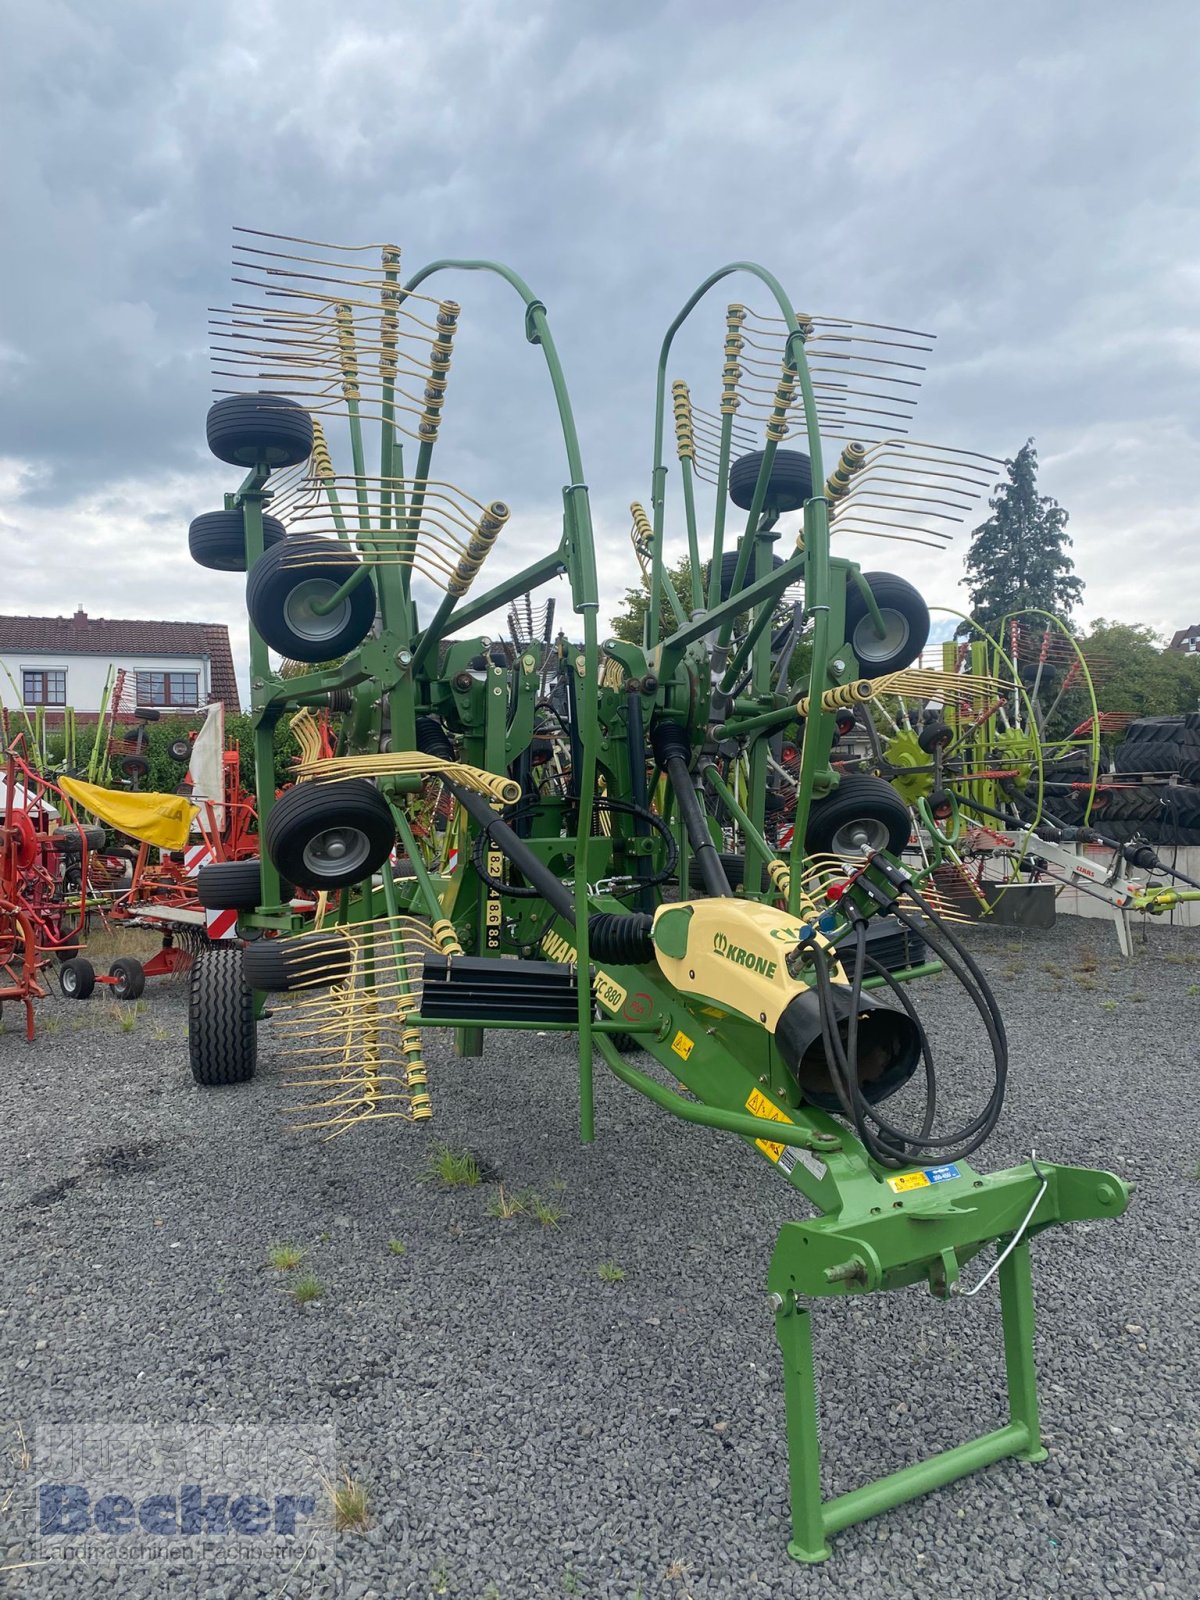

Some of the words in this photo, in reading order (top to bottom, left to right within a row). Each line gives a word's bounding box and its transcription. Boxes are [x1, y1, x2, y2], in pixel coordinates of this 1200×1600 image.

[490, 855, 501, 874] 8.2
[489, 904, 500, 923] 8.6
[488, 928, 500, 948] 8.8
[726, 943, 778, 980] KRONE
[595, 977, 608, 995] TC
[603, 986, 622, 1006] 880
